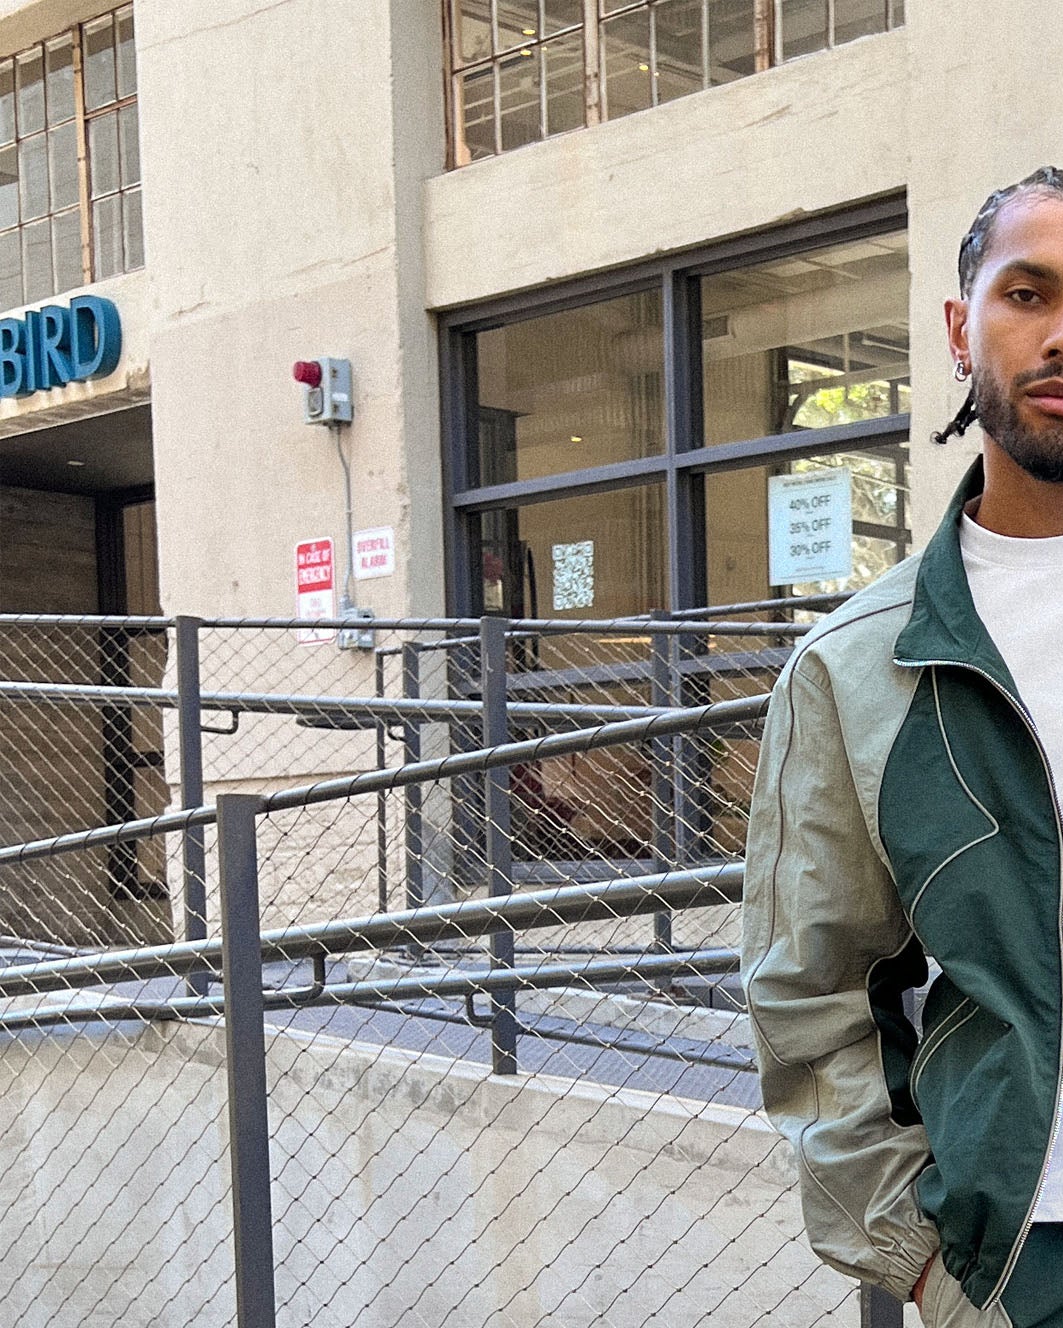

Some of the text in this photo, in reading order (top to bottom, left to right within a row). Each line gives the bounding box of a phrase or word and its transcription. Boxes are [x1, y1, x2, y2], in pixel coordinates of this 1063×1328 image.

[0, 294, 123, 399] BIRD
[789, 495, 832, 511] 40% OFF
[789, 518, 833, 534] 35% OFF
[789, 541, 832, 557] 30% OFF
